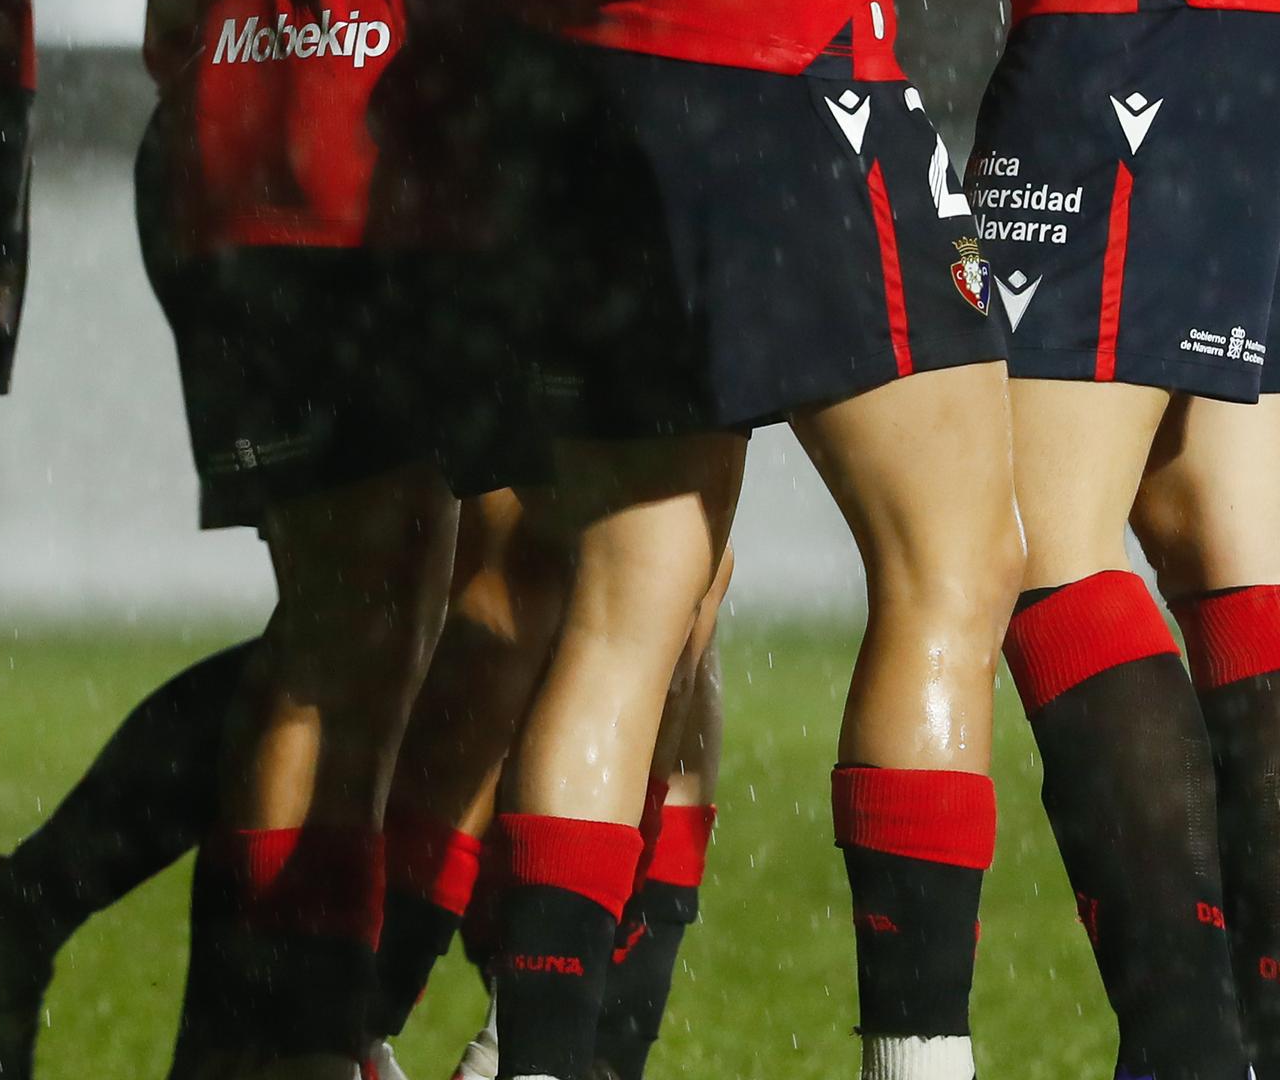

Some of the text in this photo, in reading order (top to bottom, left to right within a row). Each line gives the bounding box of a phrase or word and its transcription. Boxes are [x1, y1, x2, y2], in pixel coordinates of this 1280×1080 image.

[212, 9, 390, 68] Mobekip
[975, 151, 1019, 177] nica
[970, 183, 1083, 213] iversidad
[1180, 340, 1224, 357] de Navarra
[1189, 328, 1227, 345] Gobierno
[513, 953, 585, 977] SUNA
